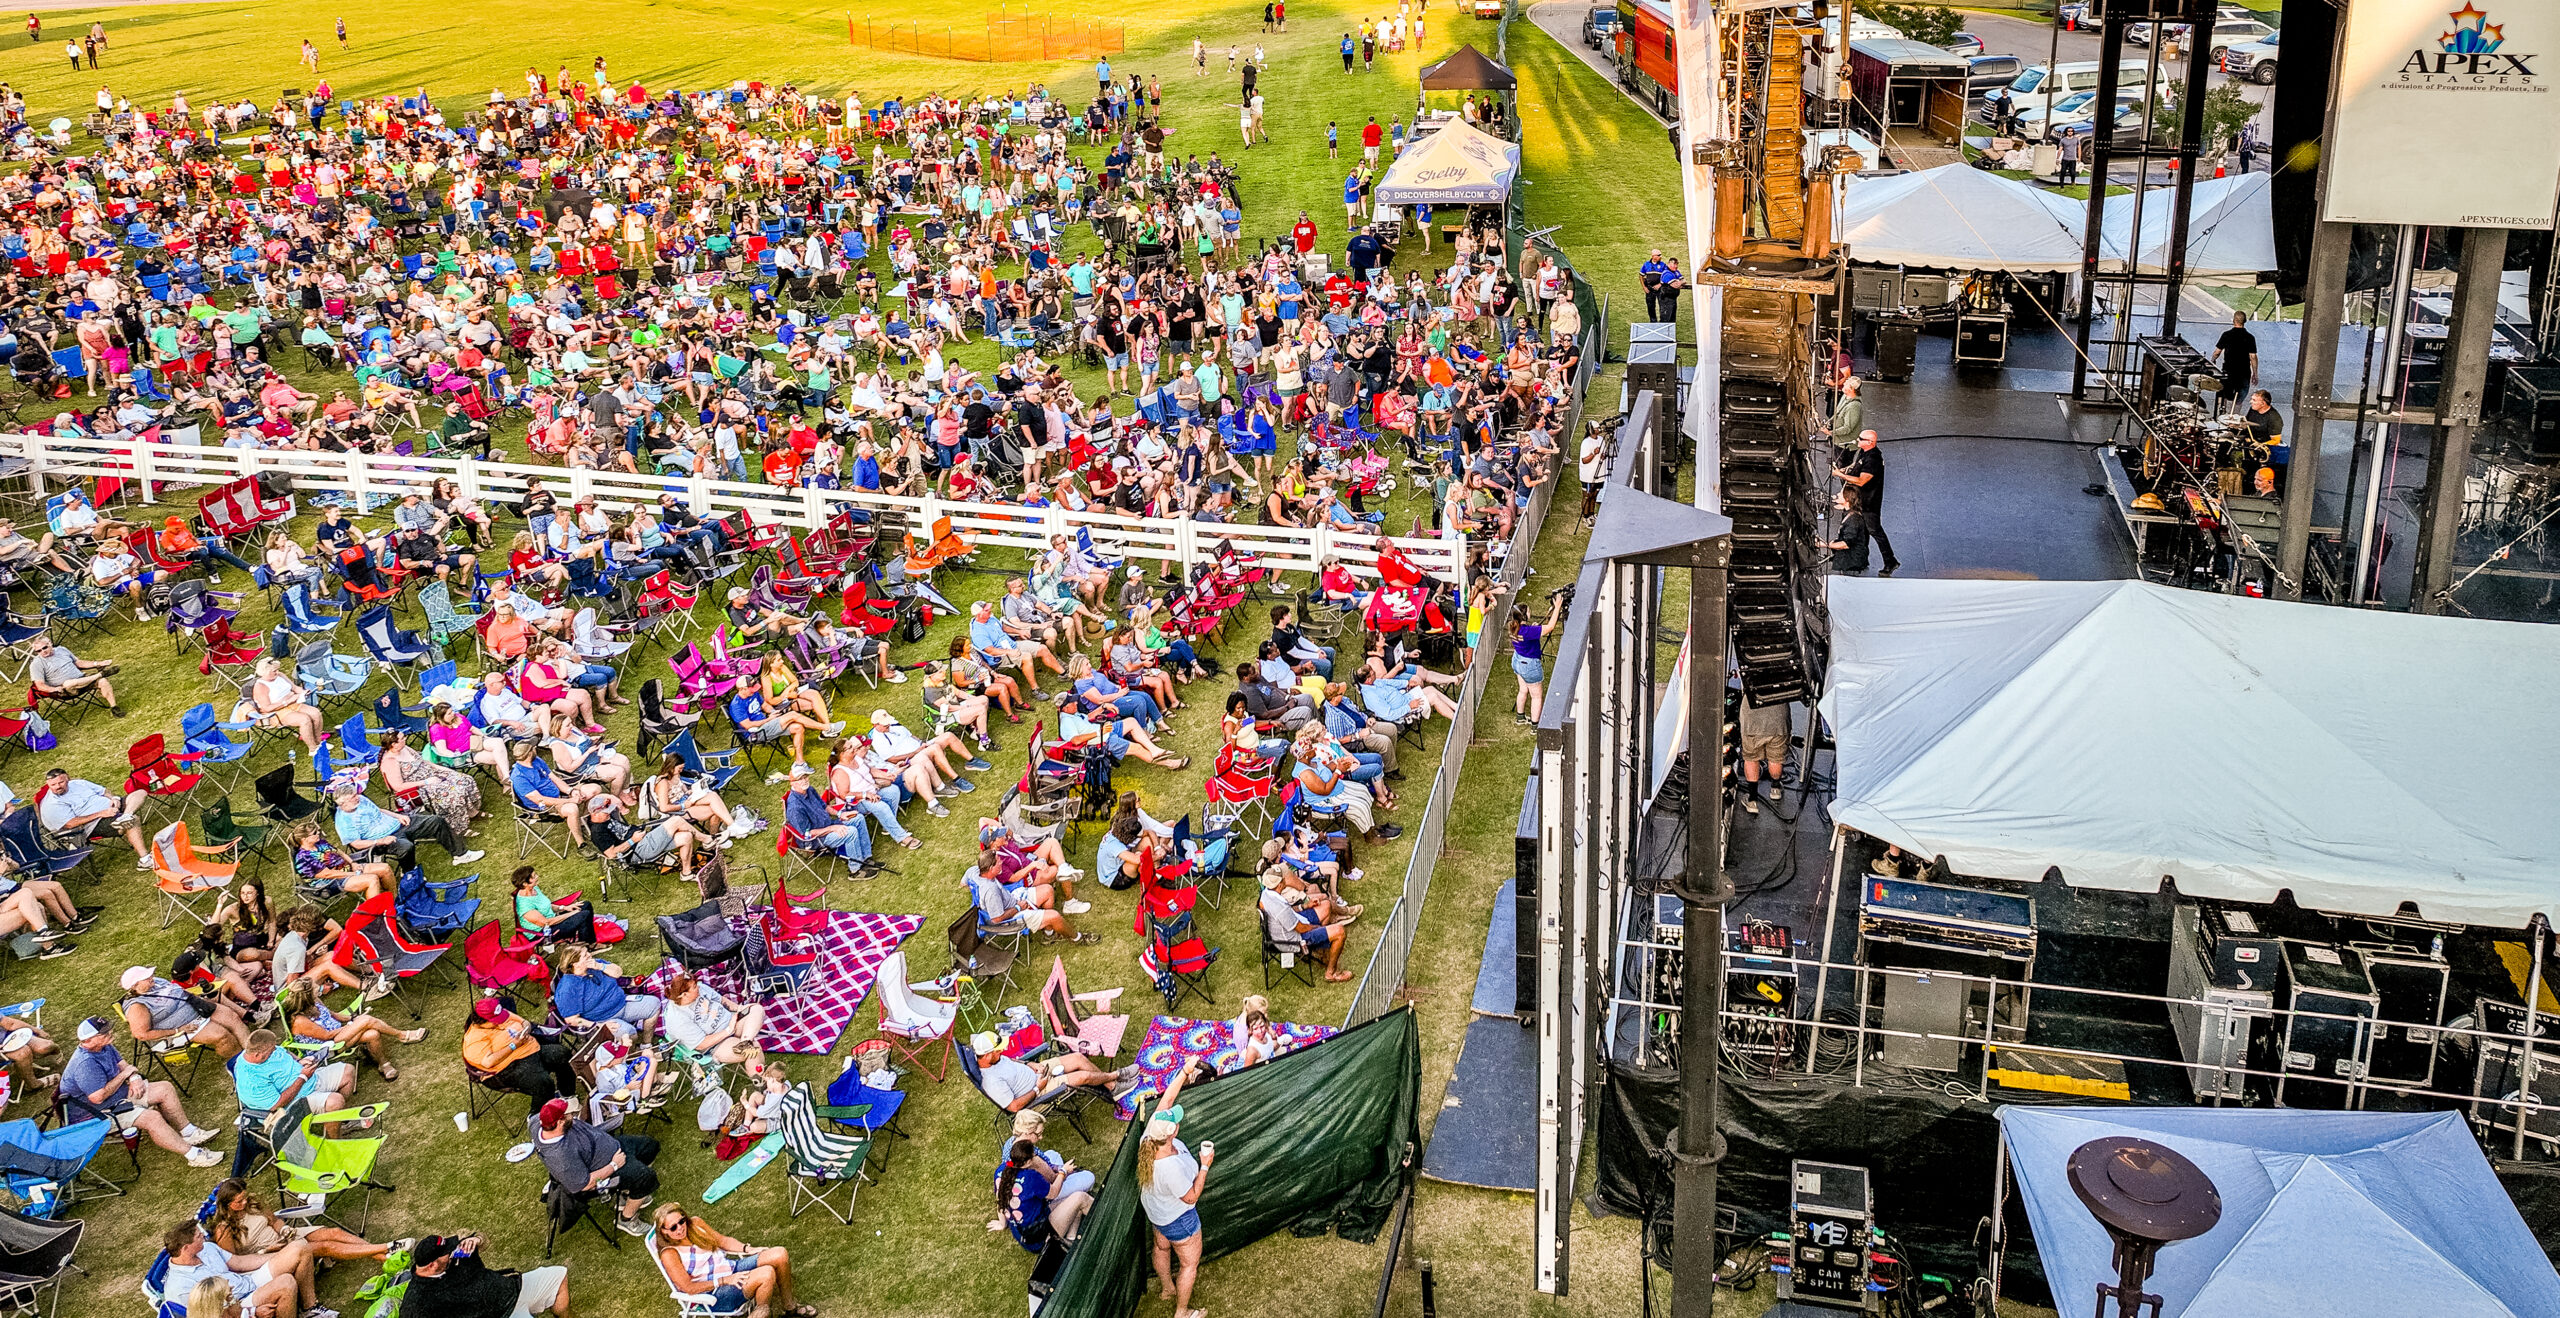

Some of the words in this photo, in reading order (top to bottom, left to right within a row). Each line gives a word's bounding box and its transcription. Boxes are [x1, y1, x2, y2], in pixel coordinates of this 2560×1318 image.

[2398, 49, 2538, 76] APEX
[2401, 74, 2531, 84] STAGES
[1414, 166, 1468, 184] Shelby
[1394, 191, 1485, 199] DISCOVERSHELBY.COM
[2459, 215, 2549, 226] APEXSTAGES.COM
[1818, 1268, 1841, 1279] CAM
[1810, 1279, 1844, 1290] SPLIT
